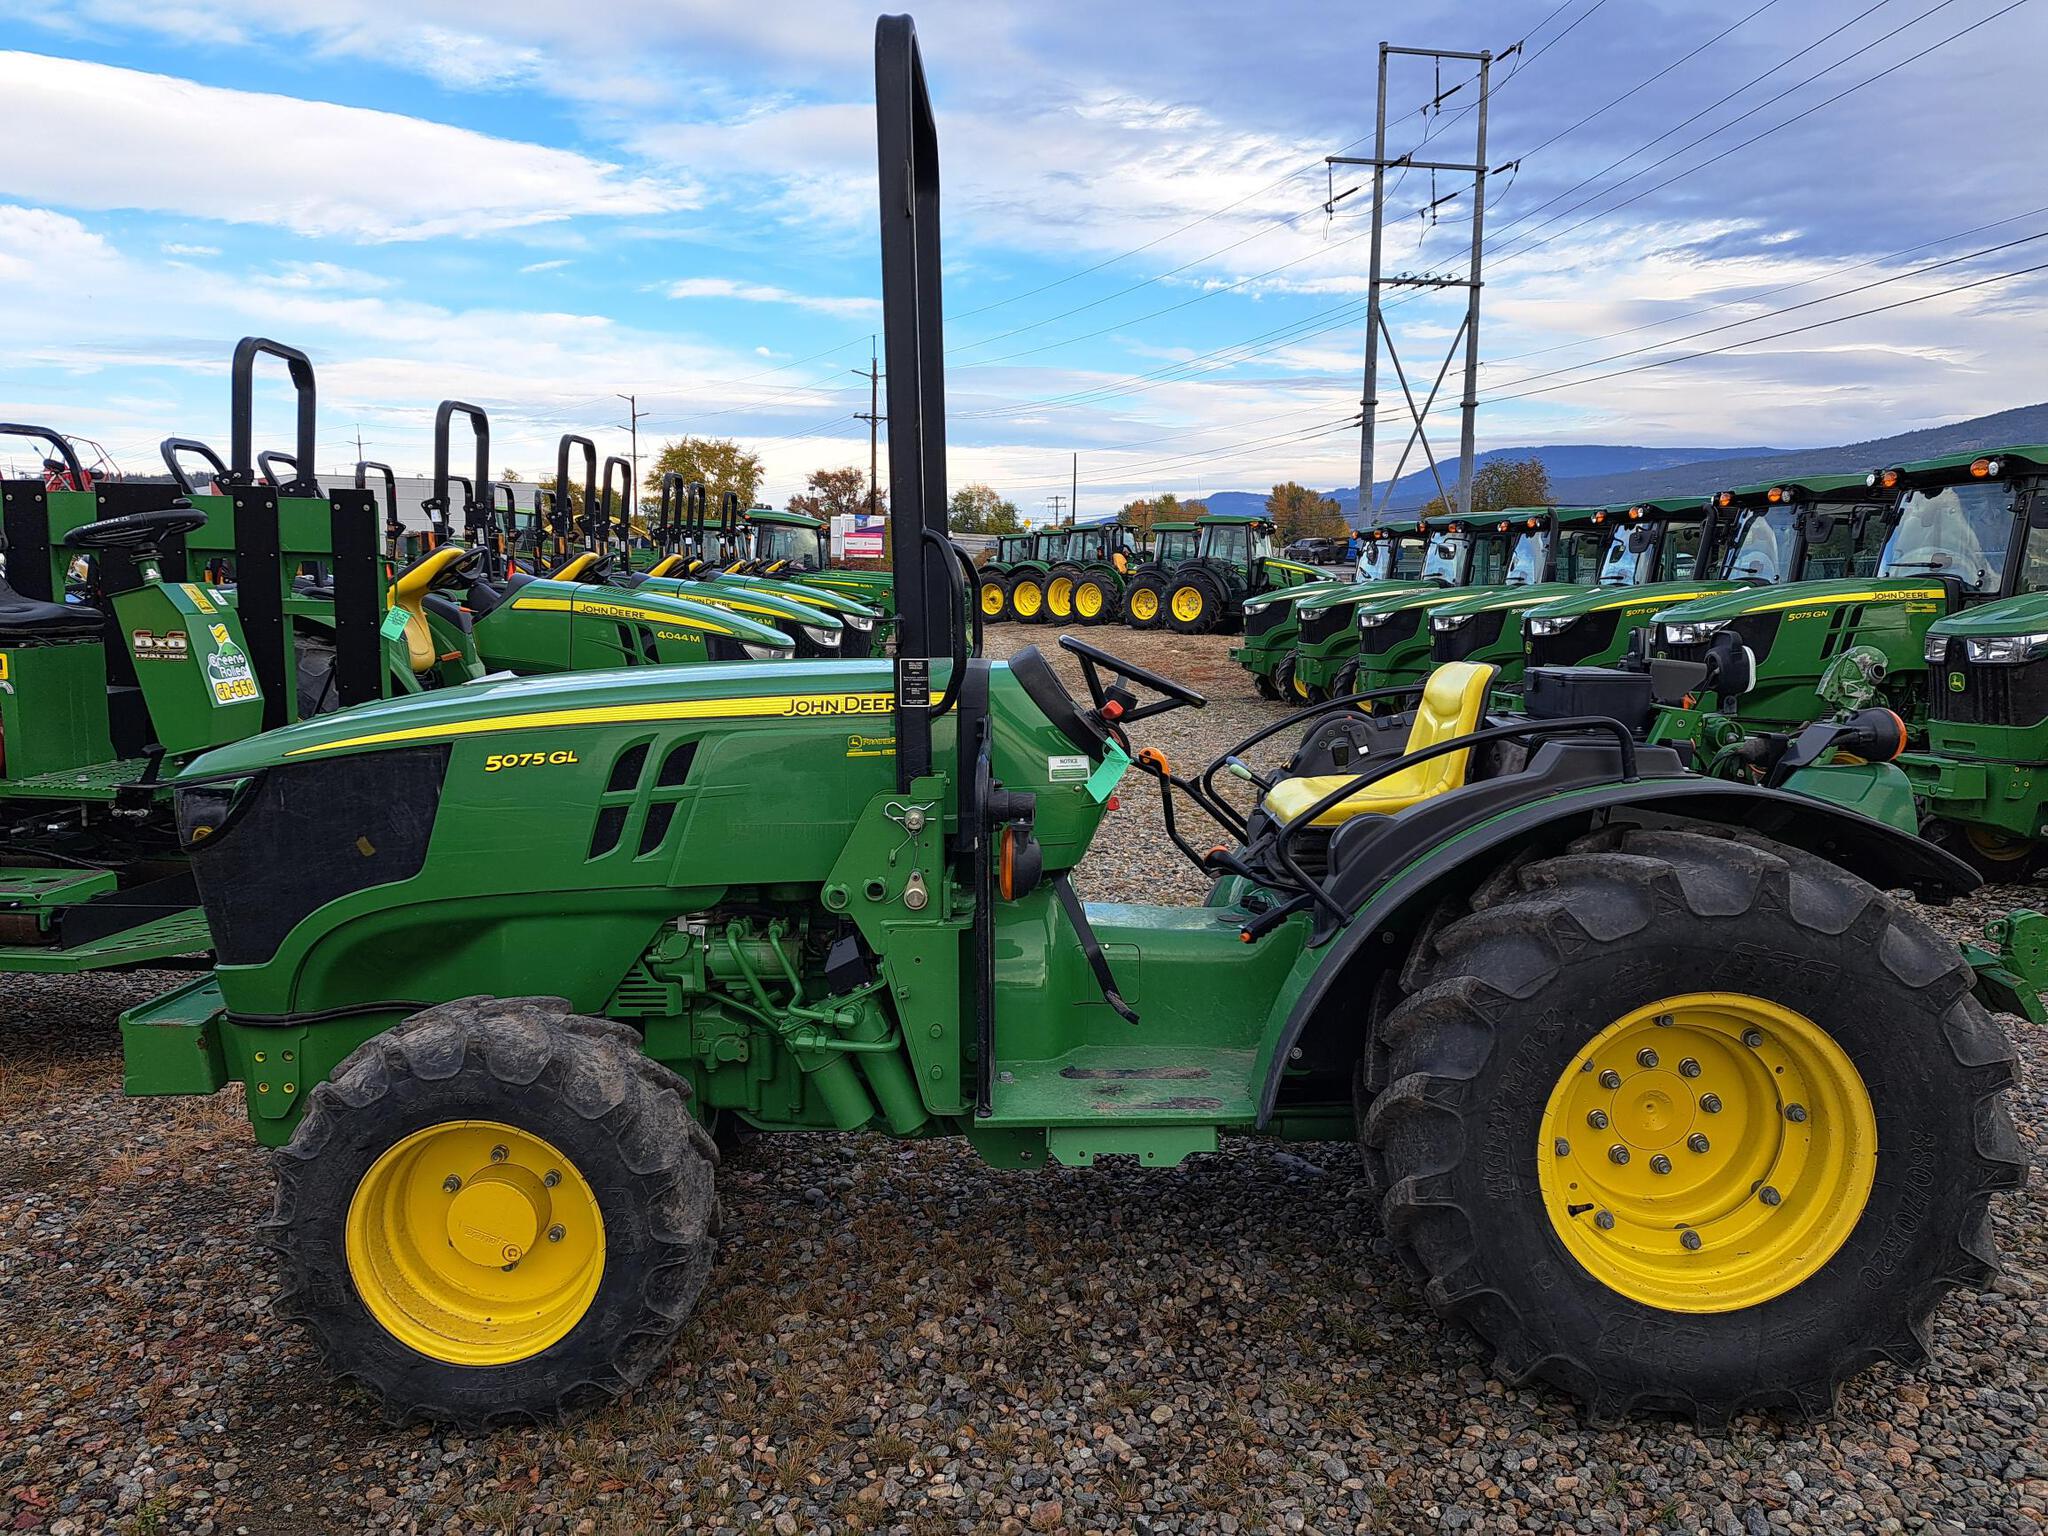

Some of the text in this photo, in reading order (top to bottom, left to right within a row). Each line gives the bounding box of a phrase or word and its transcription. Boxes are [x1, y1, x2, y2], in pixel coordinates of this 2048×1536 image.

[1872, 591, 1929, 600] JOHN DEERE
[580, 604, 645, 619] JOHN DEERE
[1788, 609, 1829, 622] 5075 GN
[657, 630, 701, 643] 4044M
[215, 677, 256, 700] GR-660
[784, 696, 896, 714] JOHN DEER
[485, 750, 579, 772] 5075 GL
